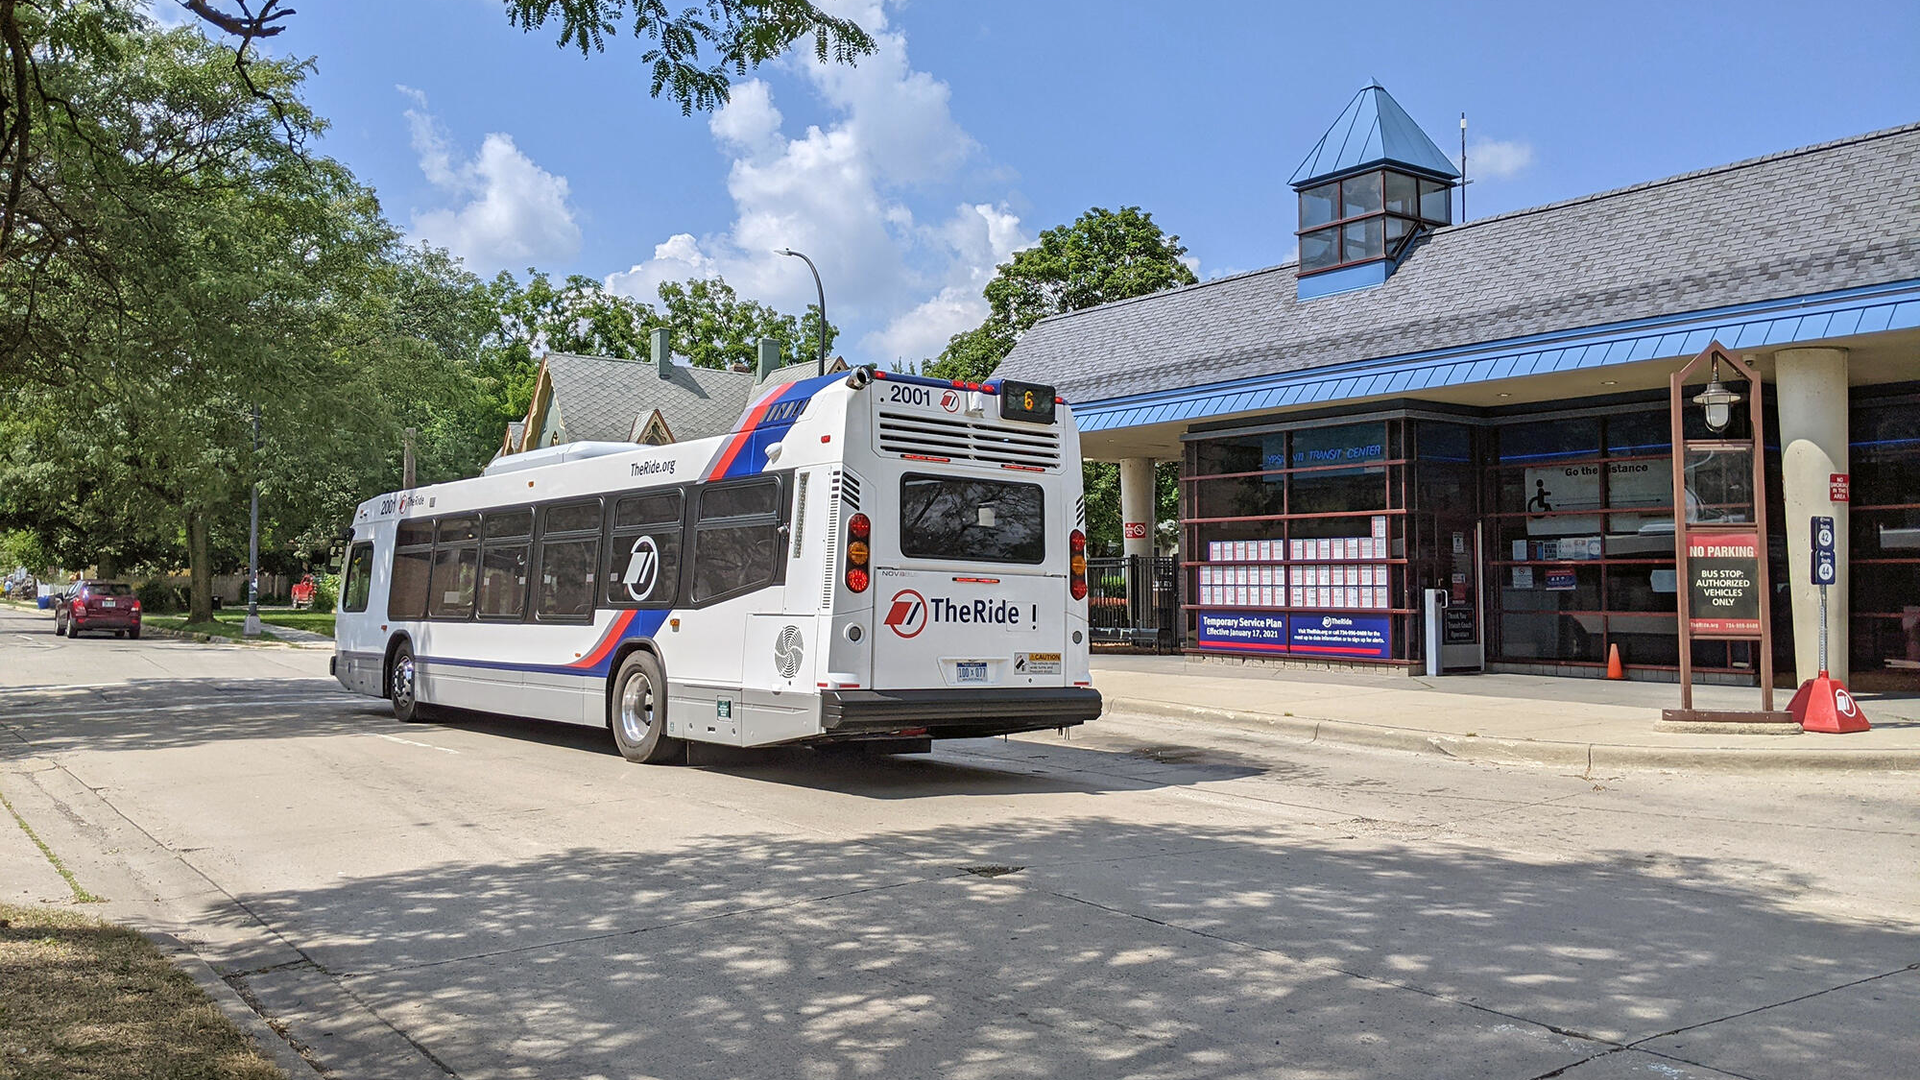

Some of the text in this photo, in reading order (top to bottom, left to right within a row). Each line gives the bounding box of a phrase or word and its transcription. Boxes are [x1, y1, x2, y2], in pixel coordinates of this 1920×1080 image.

[890, 384, 931, 407] 2001
[1024, 391, 1034, 410] 6
[1309, 449, 1341, 460] TRANSIT
[1347, 444, 1381, 459] CENTER
[631, 459, 676, 476] TheRide.org
[1565, 463, 1649, 476] Go the istance
[380, 499, 397, 515] 2001
[1821, 532, 1829, 543] 42
[1689, 546, 1754, 557] NO PARKING
[1701, 570, 1744, 578] BUS STOP:
[1821, 566, 1830, 576] 44
[1695, 579, 1750, 587] AUTHORIZED
[1703, 588, 1743, 597] VEHICLES
[1712, 598, 1735, 606] ONLY
[930, 597, 1019, 624] TheRide
[1203, 616, 1283, 628] Temporary Service Plan
[1331, 617, 1353, 625] TheRide
[1206, 627, 1278, 638] Effective January 17, 2021
[1034, 653, 1061, 661] CAUTION
